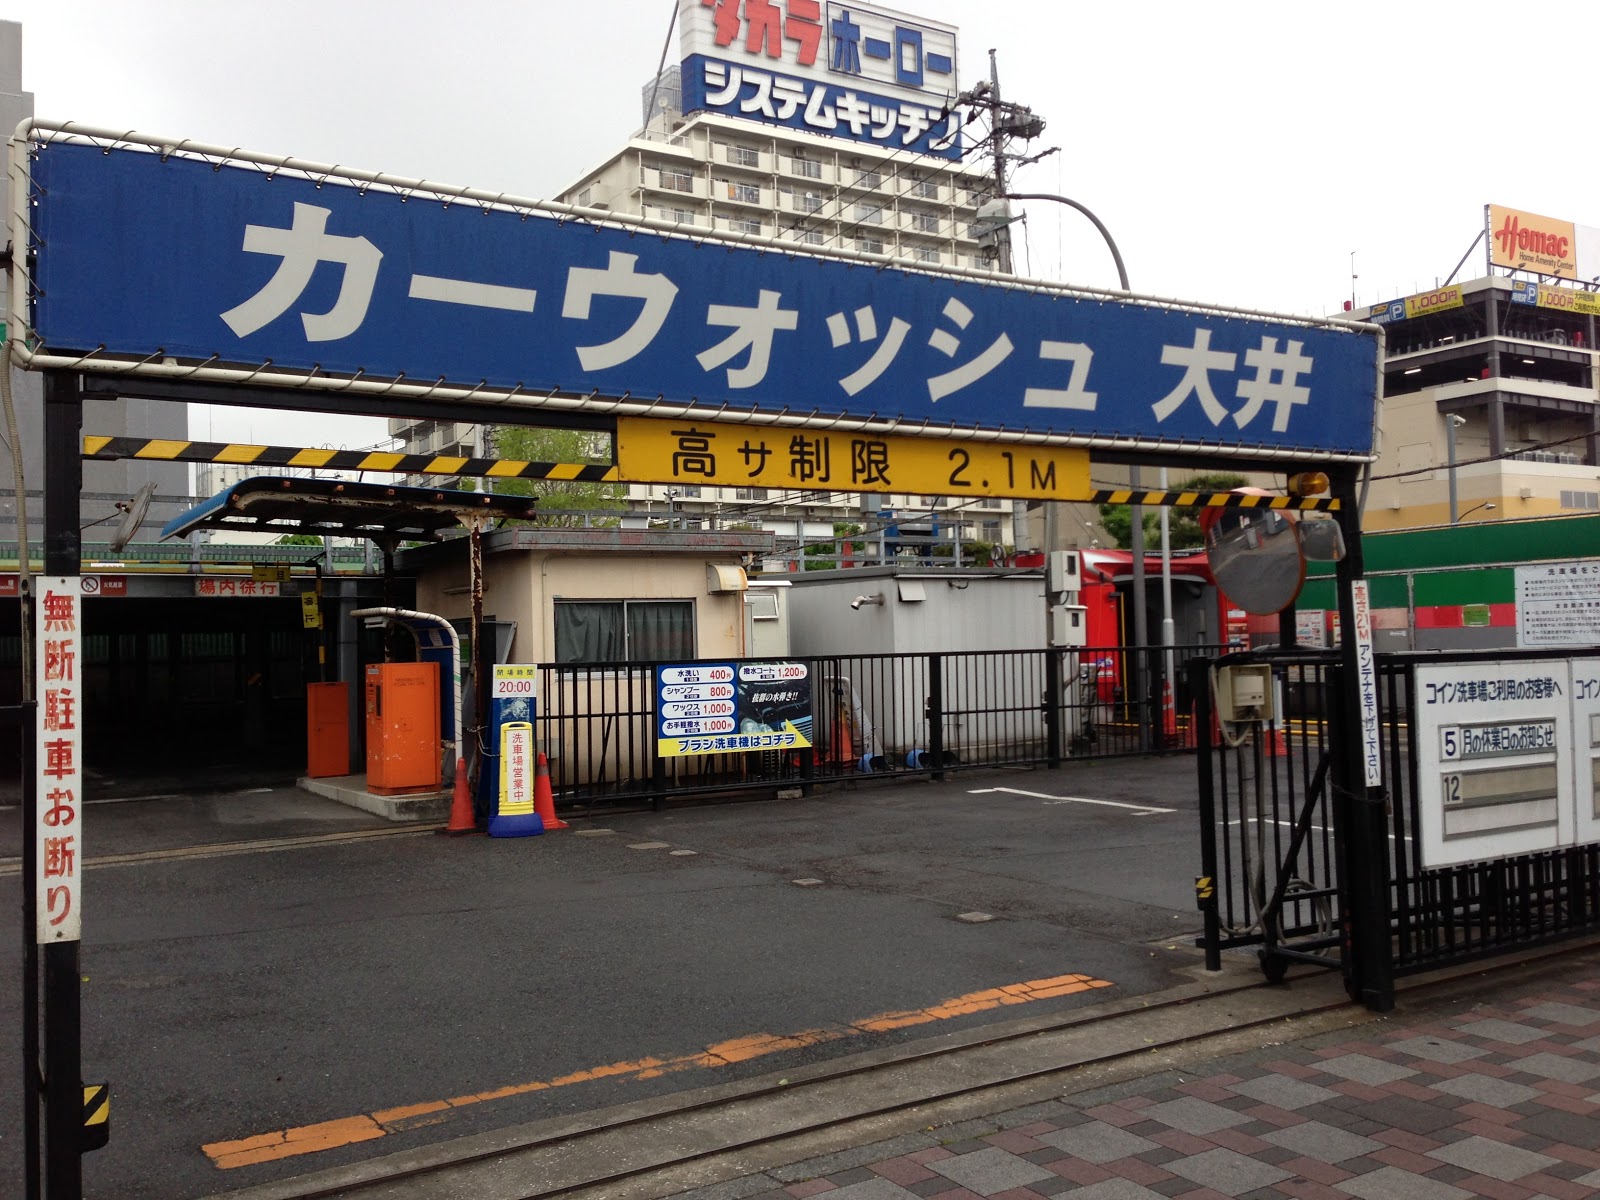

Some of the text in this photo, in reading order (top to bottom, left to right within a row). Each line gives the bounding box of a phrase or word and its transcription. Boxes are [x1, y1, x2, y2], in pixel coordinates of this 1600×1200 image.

[832, 10, 952, 87] ホーロー
[705, 61, 960, 151] システムキッチン
[1495, 215, 1569, 260] Homac
[1519, 251, 1574, 271] Home Amenity Center
[219, 201, 1314, 433] カーウォッシュ 大井
[670, 426, 1058, 491] 高サ制限 2.1M
[198, 578, 277, 595] 場内徐行
[677, 669, 700, 677] 水洗い
[709, 670, 731, 680] 400円
[743, 667, 775, 675] 撥水コート
[777, 667, 805, 678] 1,200円
[499, 681, 531, 693] 20:00
[666, 687, 732, 697] シャンプー 800円
[1426, 677, 1563, 704] コイン洗車場ご利用のお客様へ
[703, 703, 732, 714] 1,000円
[1359, 644, 1379, 780] アンテナを下げて下さい
[667, 721, 701, 729] お手軽撥水
[703, 720, 732, 731] 1,000円
[678, 733, 797, 753] ブラシ洗車機はコチラ
[1445, 731, 1456, 756] 5
[1463, 725, 1554, 754] 月の休業日のお知らせ
[42, 589, 76, 927] 無断駐車お断り
[512, 732, 524, 801] 洗車場営業中
[1444, 775, 1460, 801] 12
